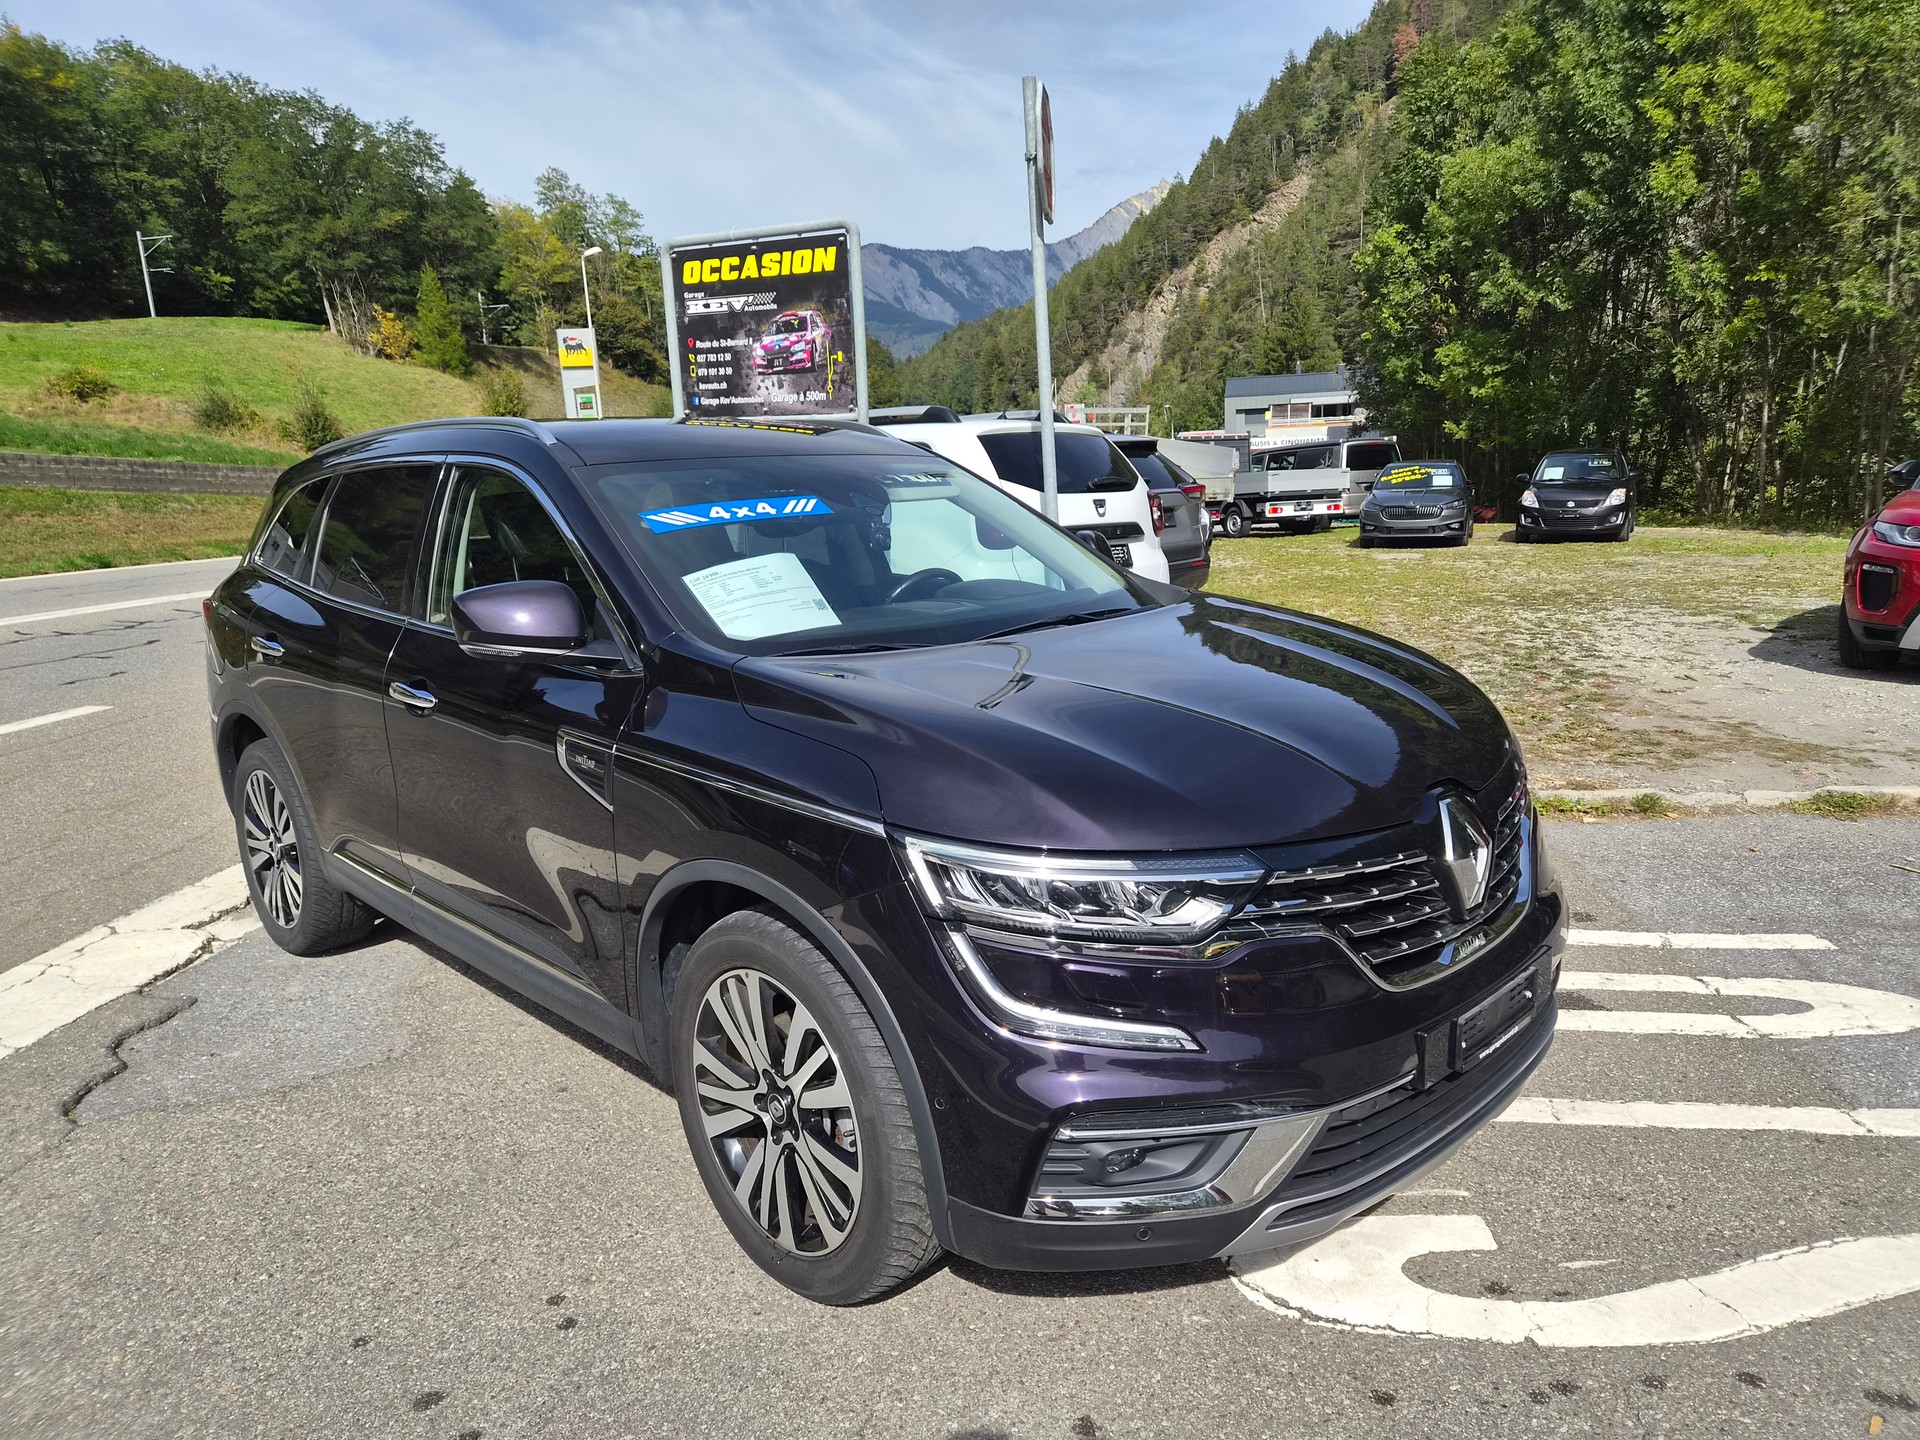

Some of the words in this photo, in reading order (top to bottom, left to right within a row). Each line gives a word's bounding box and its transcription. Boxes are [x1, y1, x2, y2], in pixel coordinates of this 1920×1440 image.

[682, 246, 837, 285] OCCASION
[684, 291, 705, 299] Garage
[695, 340, 711, 349] Route
[720, 337, 748, 347] St-Bernard
[696, 354, 706, 362] 027
[718, 353, 724, 361] 12
[724, 353, 732, 361] 50
[697, 368, 707, 376] 079
[725, 367, 733, 375] 50
[699, 381, 728, 390] kevauto.ch
[700, 397, 719, 406] Garage
[771, 393, 798, 404] Garage
[799, 391, 804, 401] à
[805, 390, 827, 401] 500m
[1380, 471, 1412, 482] Rabais
[708, 501, 778, 520] 4x4
